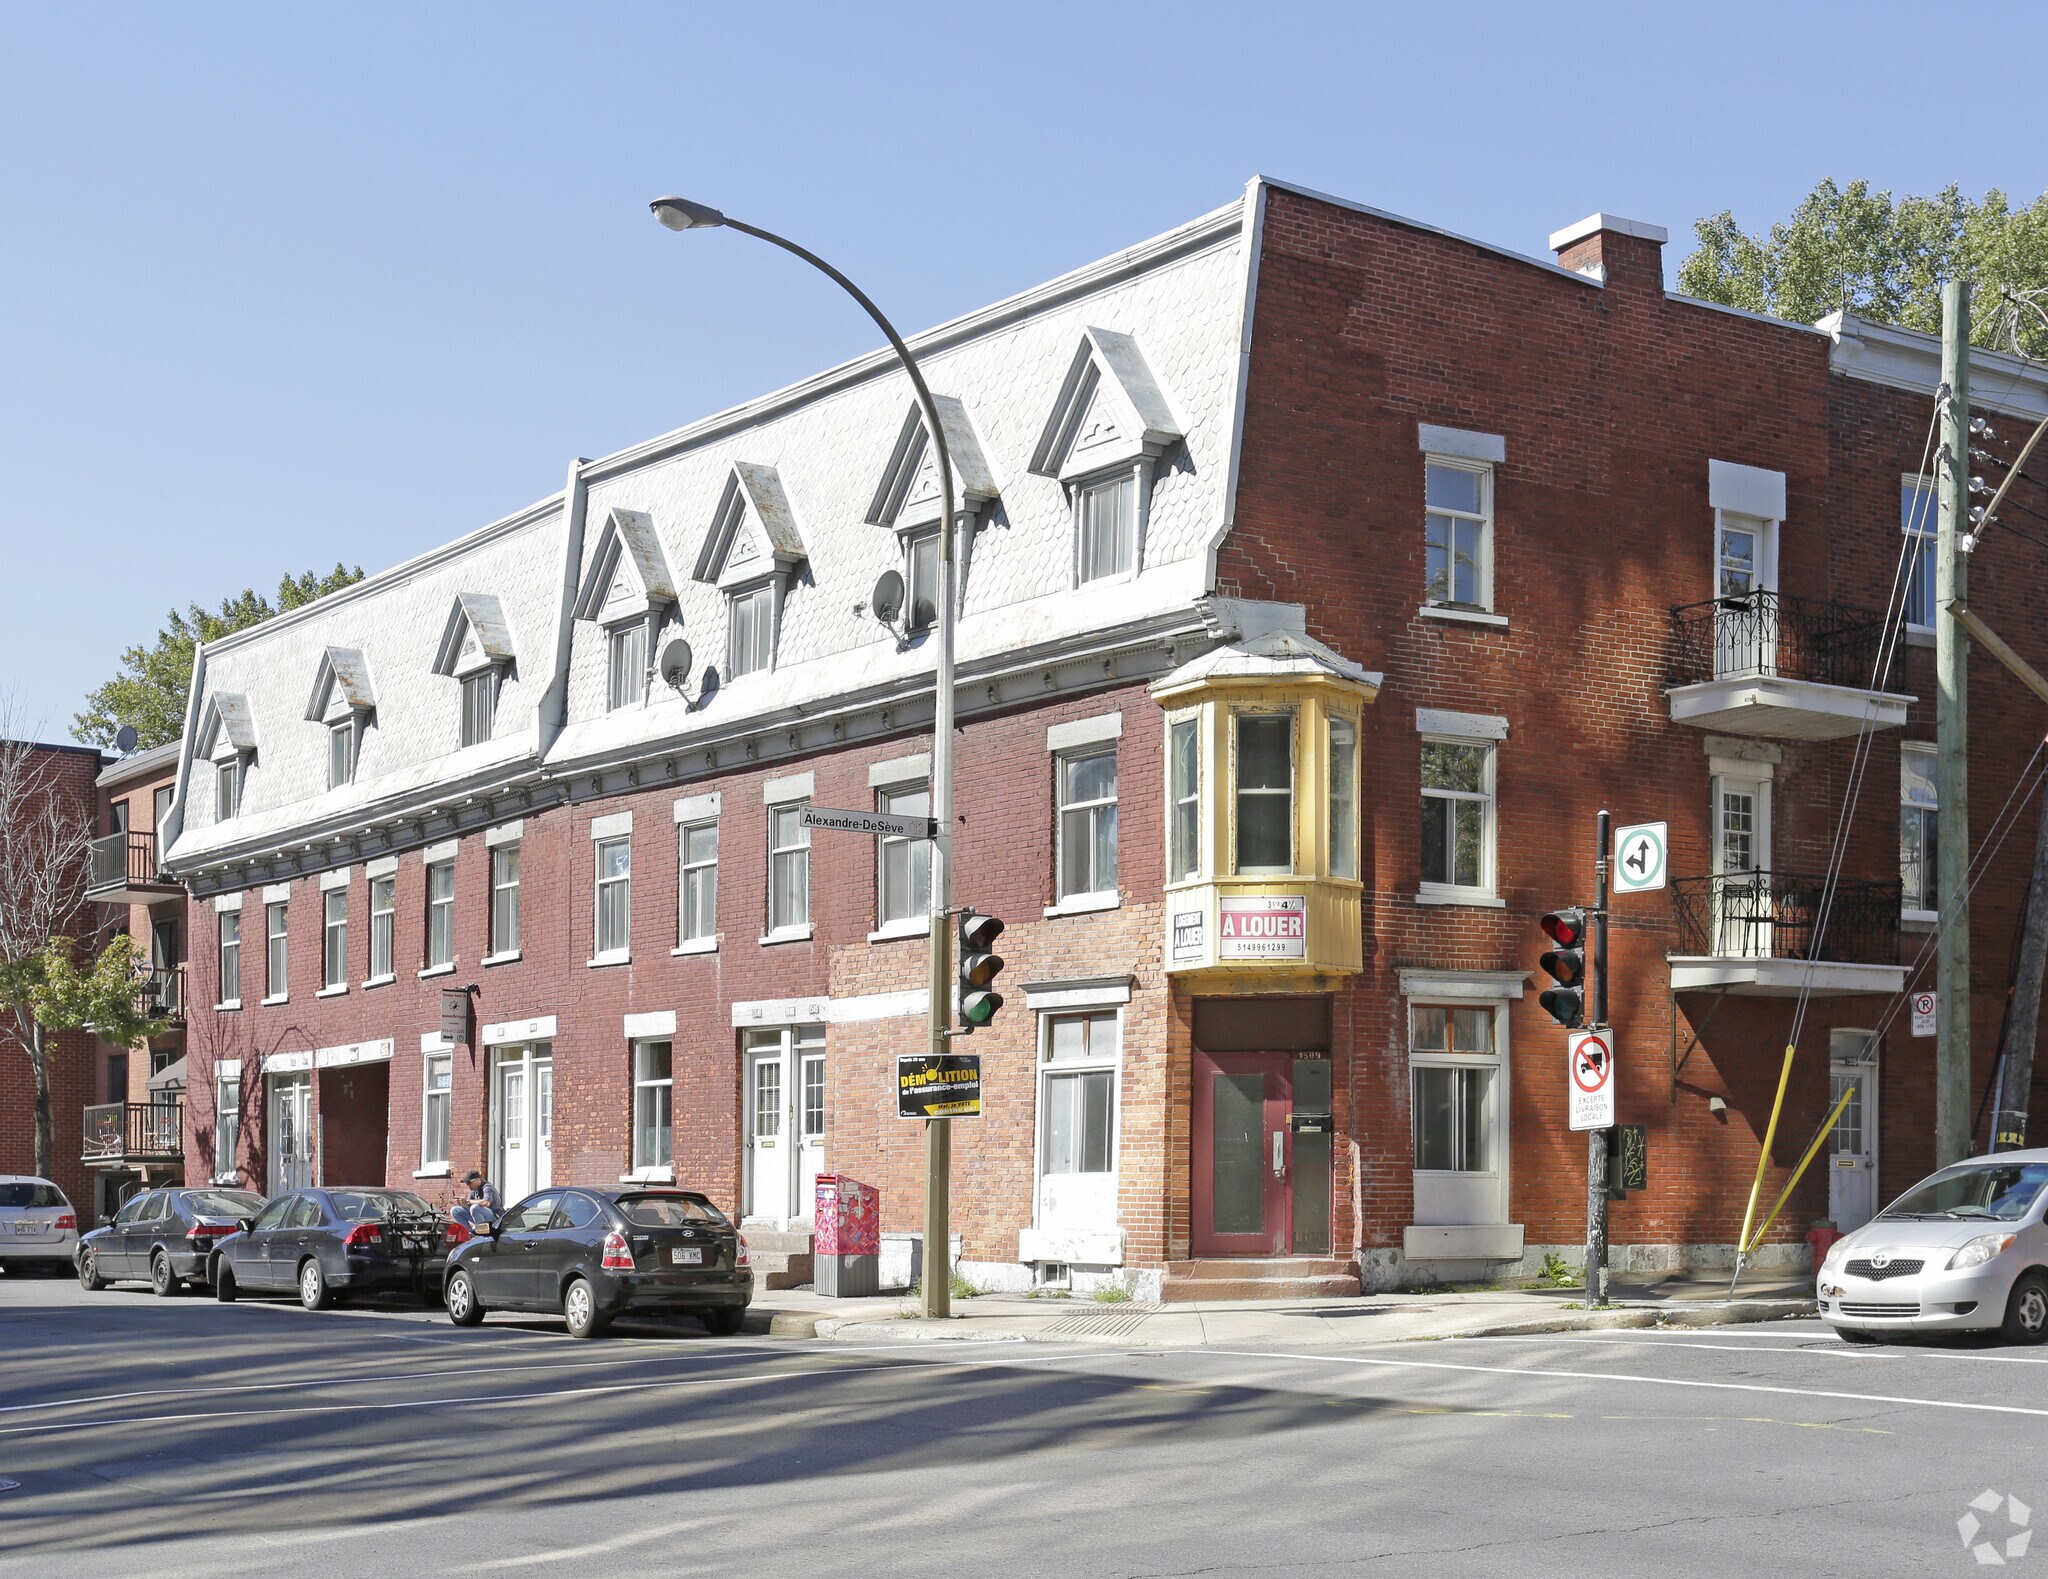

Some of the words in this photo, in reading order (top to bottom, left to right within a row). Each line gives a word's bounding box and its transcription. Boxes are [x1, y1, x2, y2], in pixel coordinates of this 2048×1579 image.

[804, 813, 904, 834] Alexandre-DeSève
[1222, 913, 1236, 936] À
[1240, 916, 1302, 937] LOUER
[1181, 926, 1203, 947] LOUER
[1237, 942, 1286, 951] 5149961299
[1298, 1051, 1320, 1060] 1509
[900, 1069, 978, 1088] DÉMOLITION
[909, 1081, 979, 1095] l'assurance-emploi
[1575, 1102, 1608, 1114] LIVRAISON
[1580, 1111, 1603, 1122] LOCALE
[673, 1251, 686, 1260] 506
[688, 1251, 701, 1260] XMC
